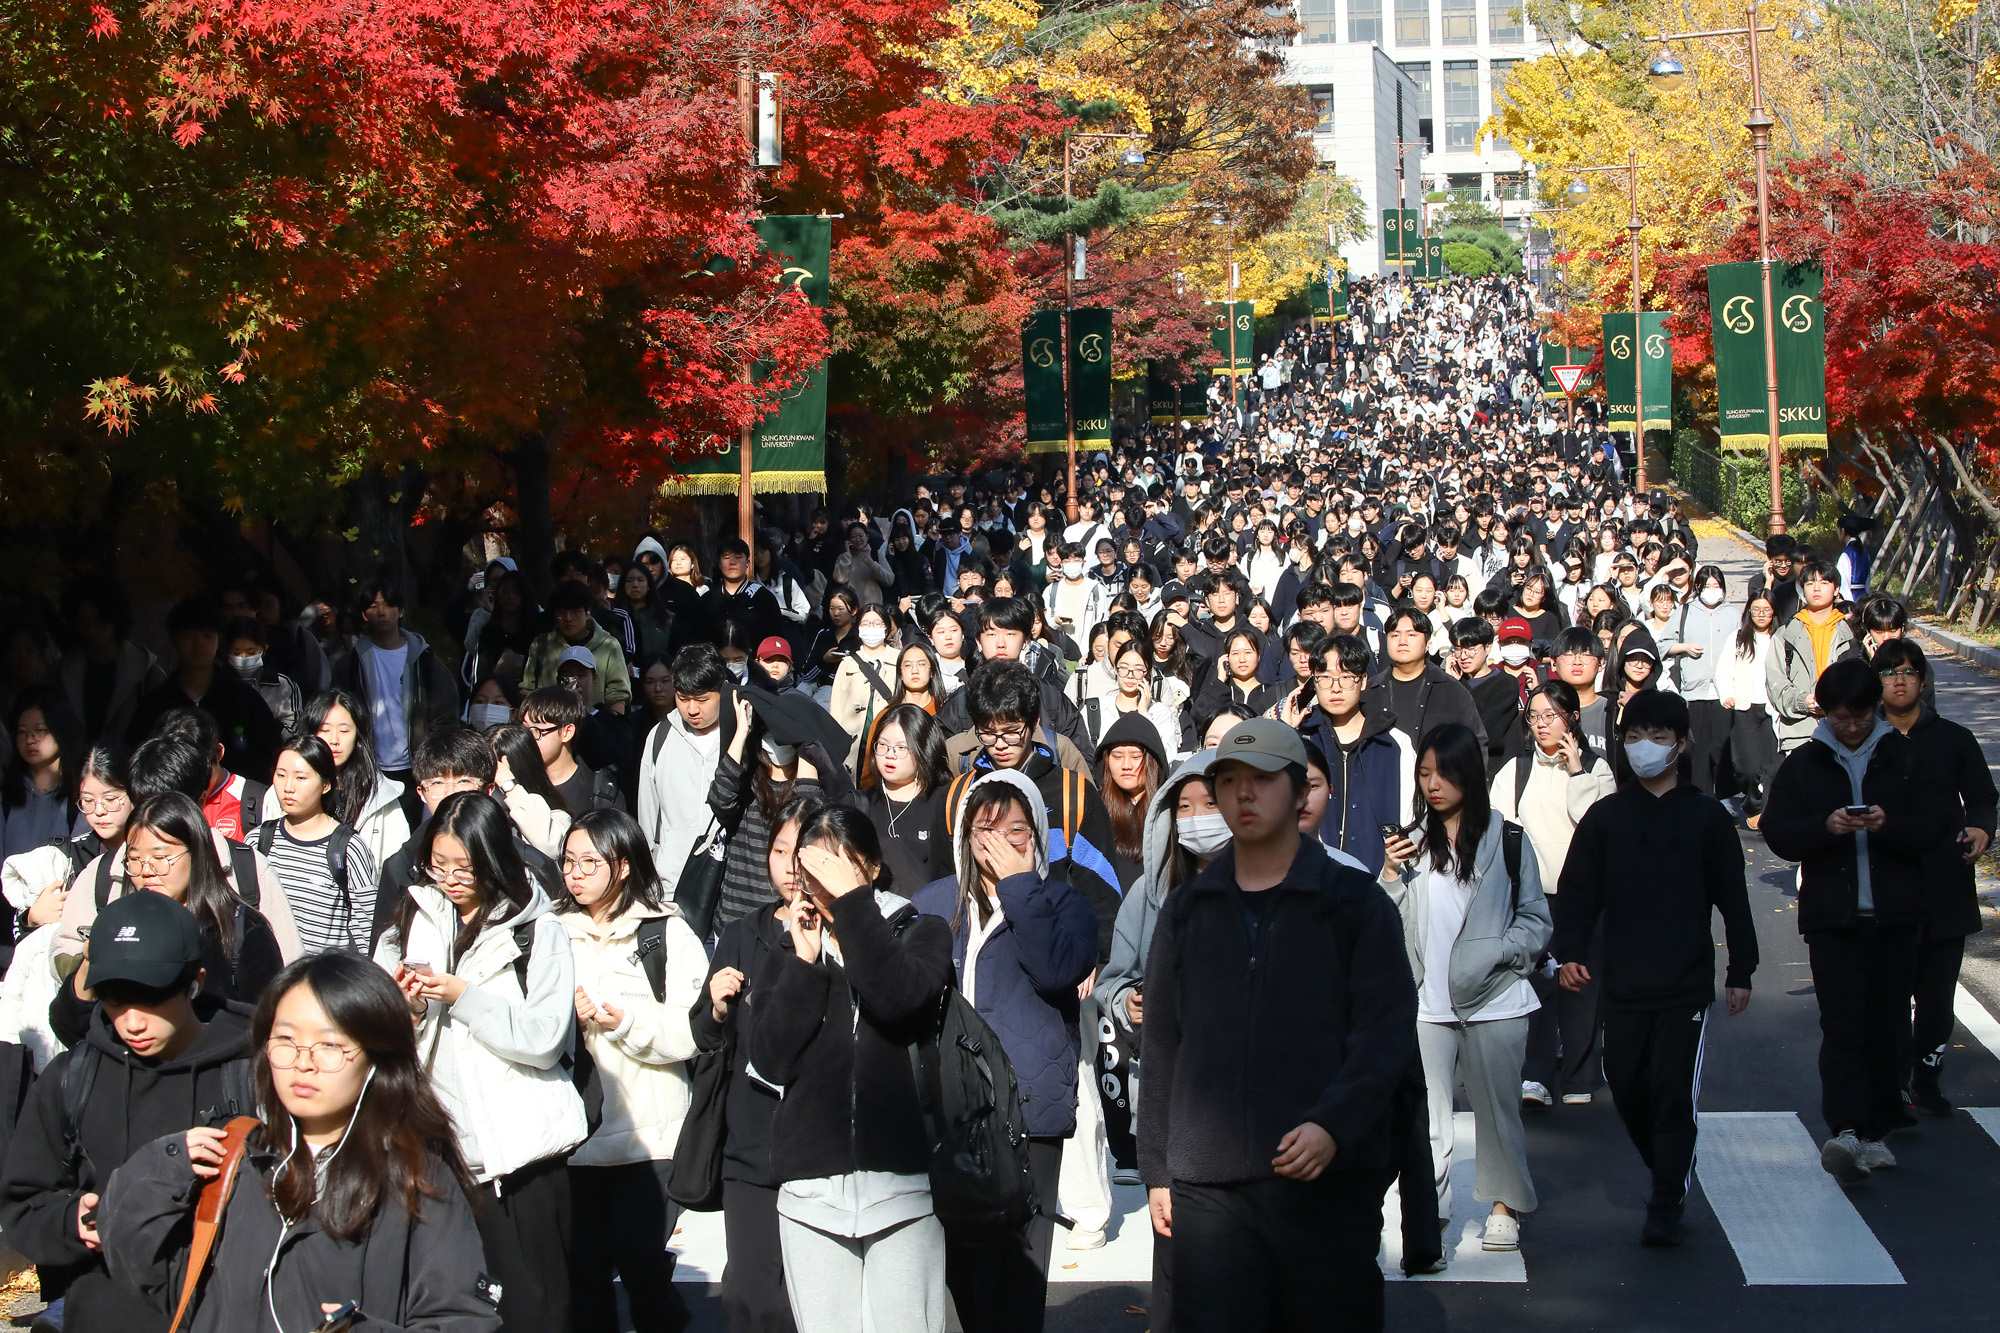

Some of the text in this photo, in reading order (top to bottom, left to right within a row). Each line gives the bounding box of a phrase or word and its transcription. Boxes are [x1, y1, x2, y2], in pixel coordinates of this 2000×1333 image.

[1235, 357, 1251, 365] SKKU
[1152, 401, 1174, 409] SKKU
[1610, 404, 1636, 414] SKKU
[1779, 406, 1821, 423] SKKU
[1076, 418, 1107, 431] SKKU
